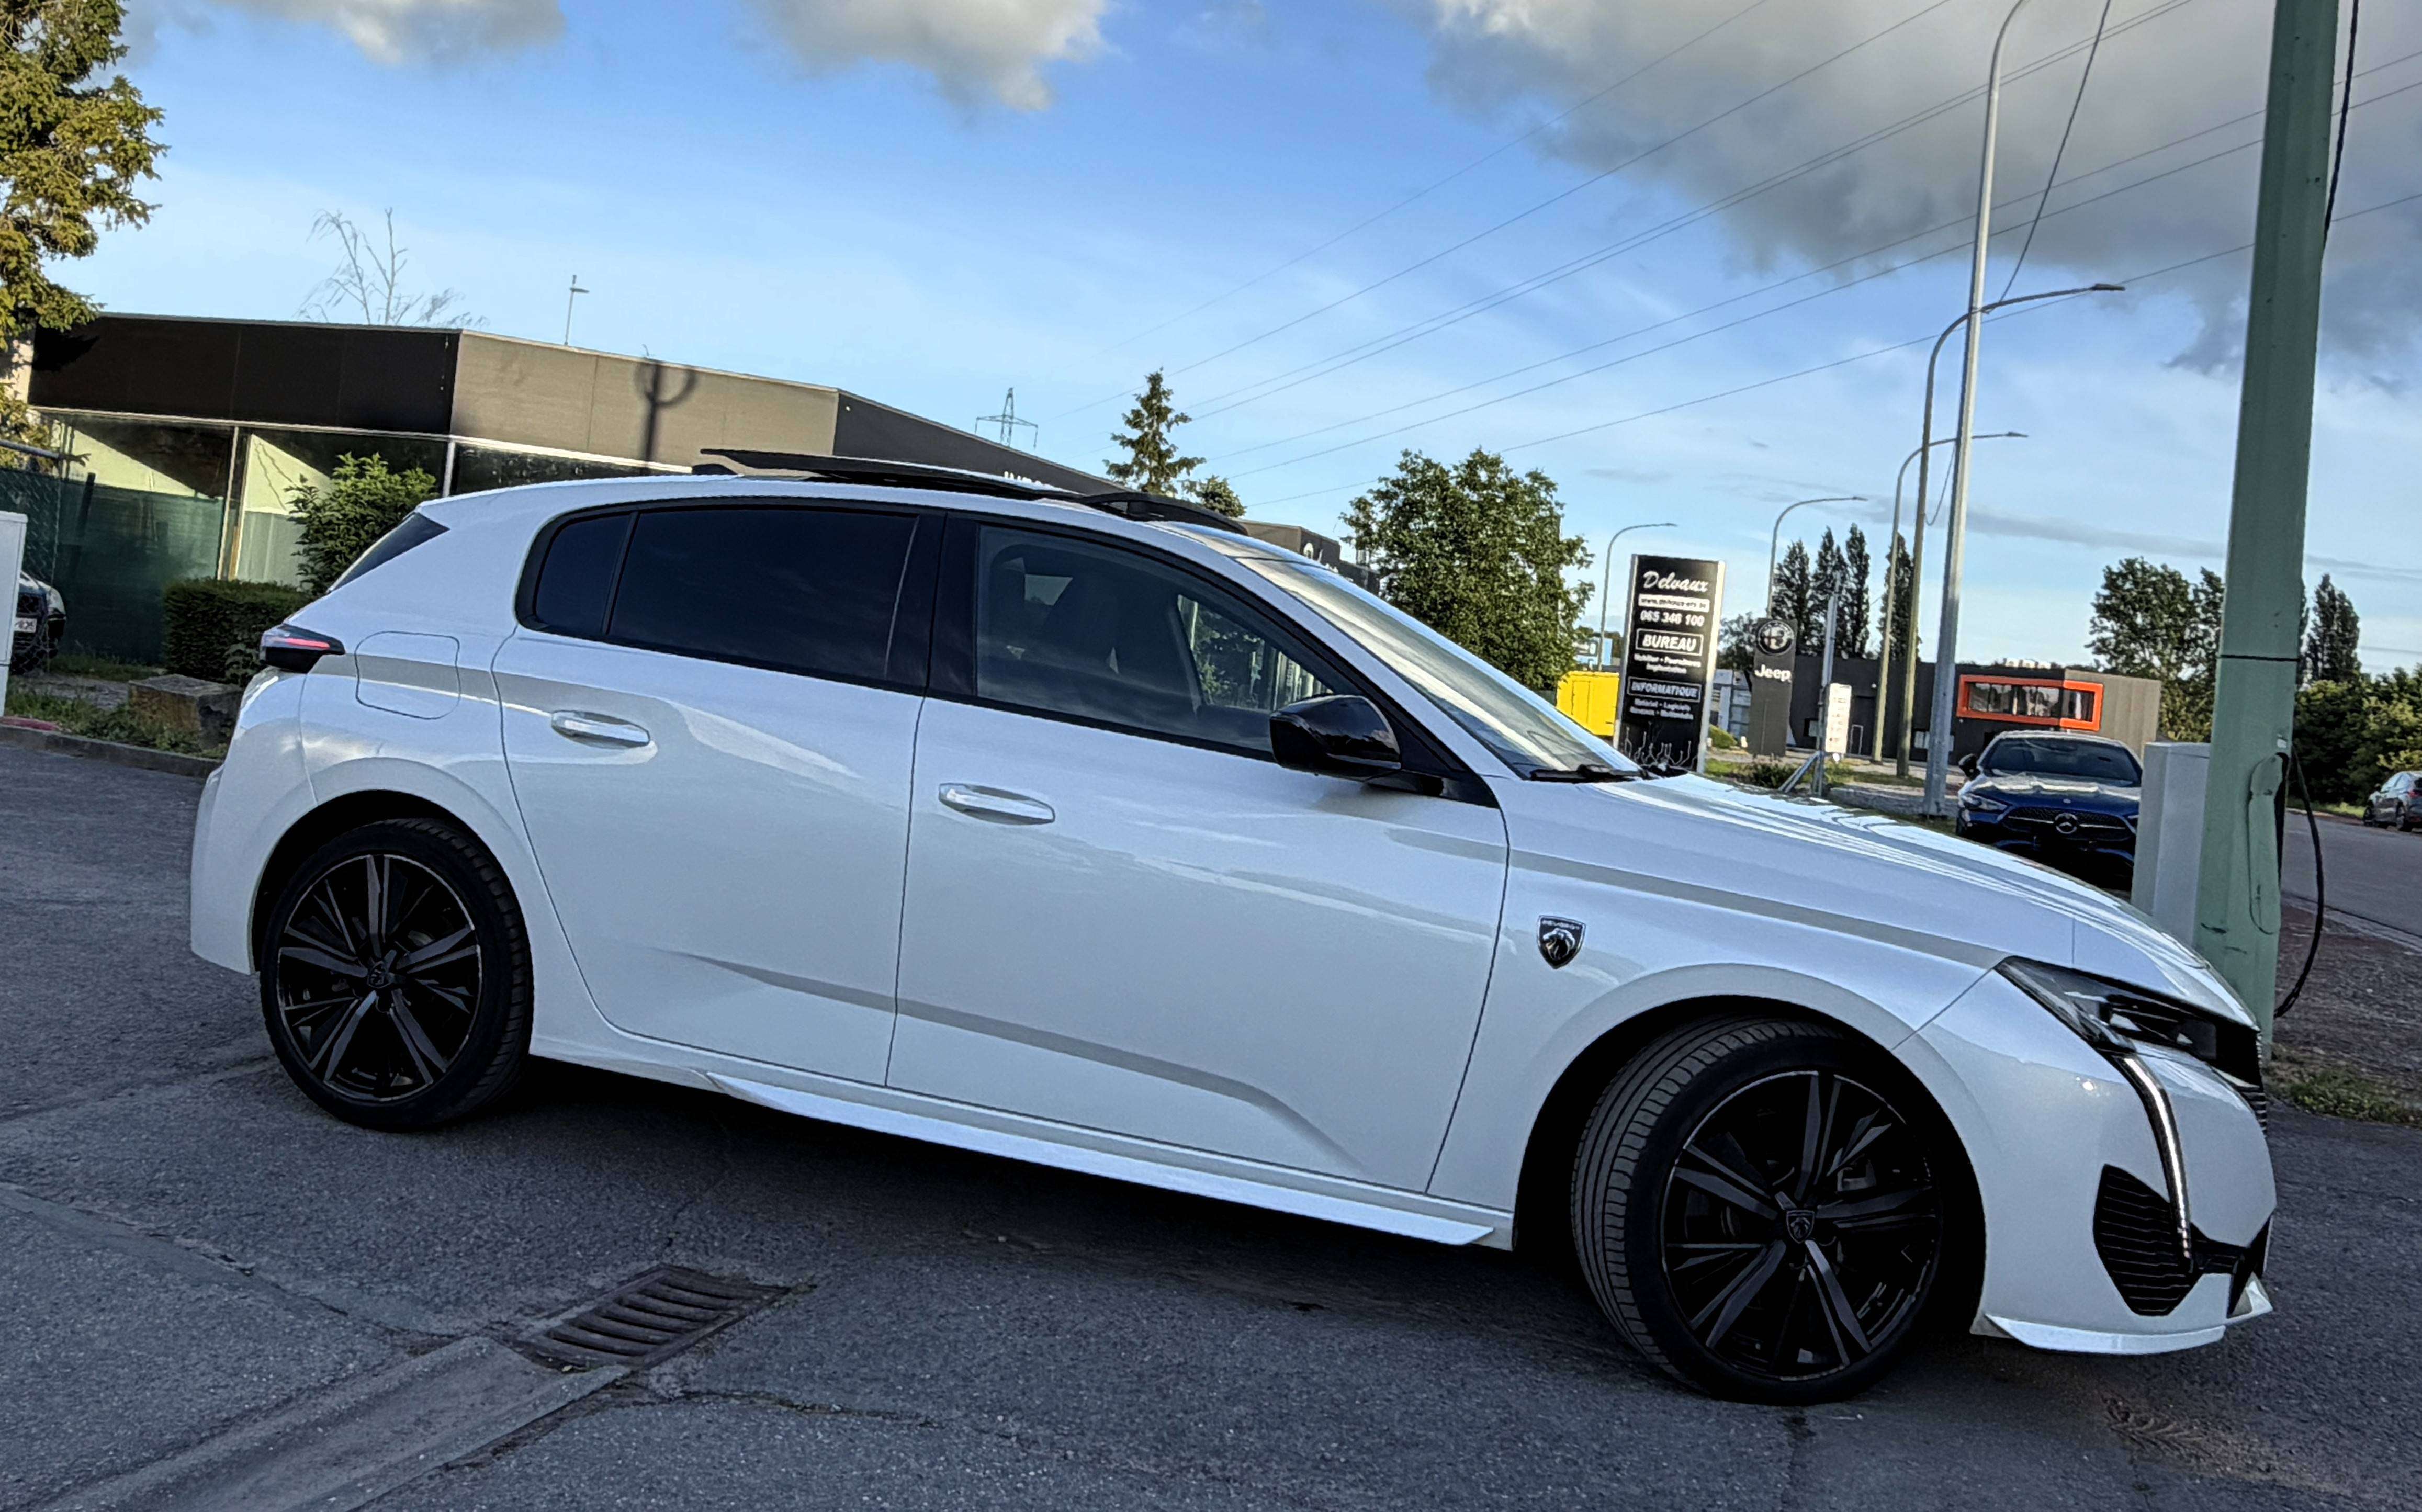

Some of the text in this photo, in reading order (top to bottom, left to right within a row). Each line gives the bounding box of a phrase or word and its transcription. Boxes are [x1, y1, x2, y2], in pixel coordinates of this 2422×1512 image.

[1643, 570, 1708, 592] Delvaux
[1640, 610, 1660, 623] 065
[1685, 614, 1705, 627] 100
[1642, 634, 1697, 651] BUREAU
[1754, 664, 1792, 682] Jeep
[1631, 681, 1698, 698] INFORMATIQUE
